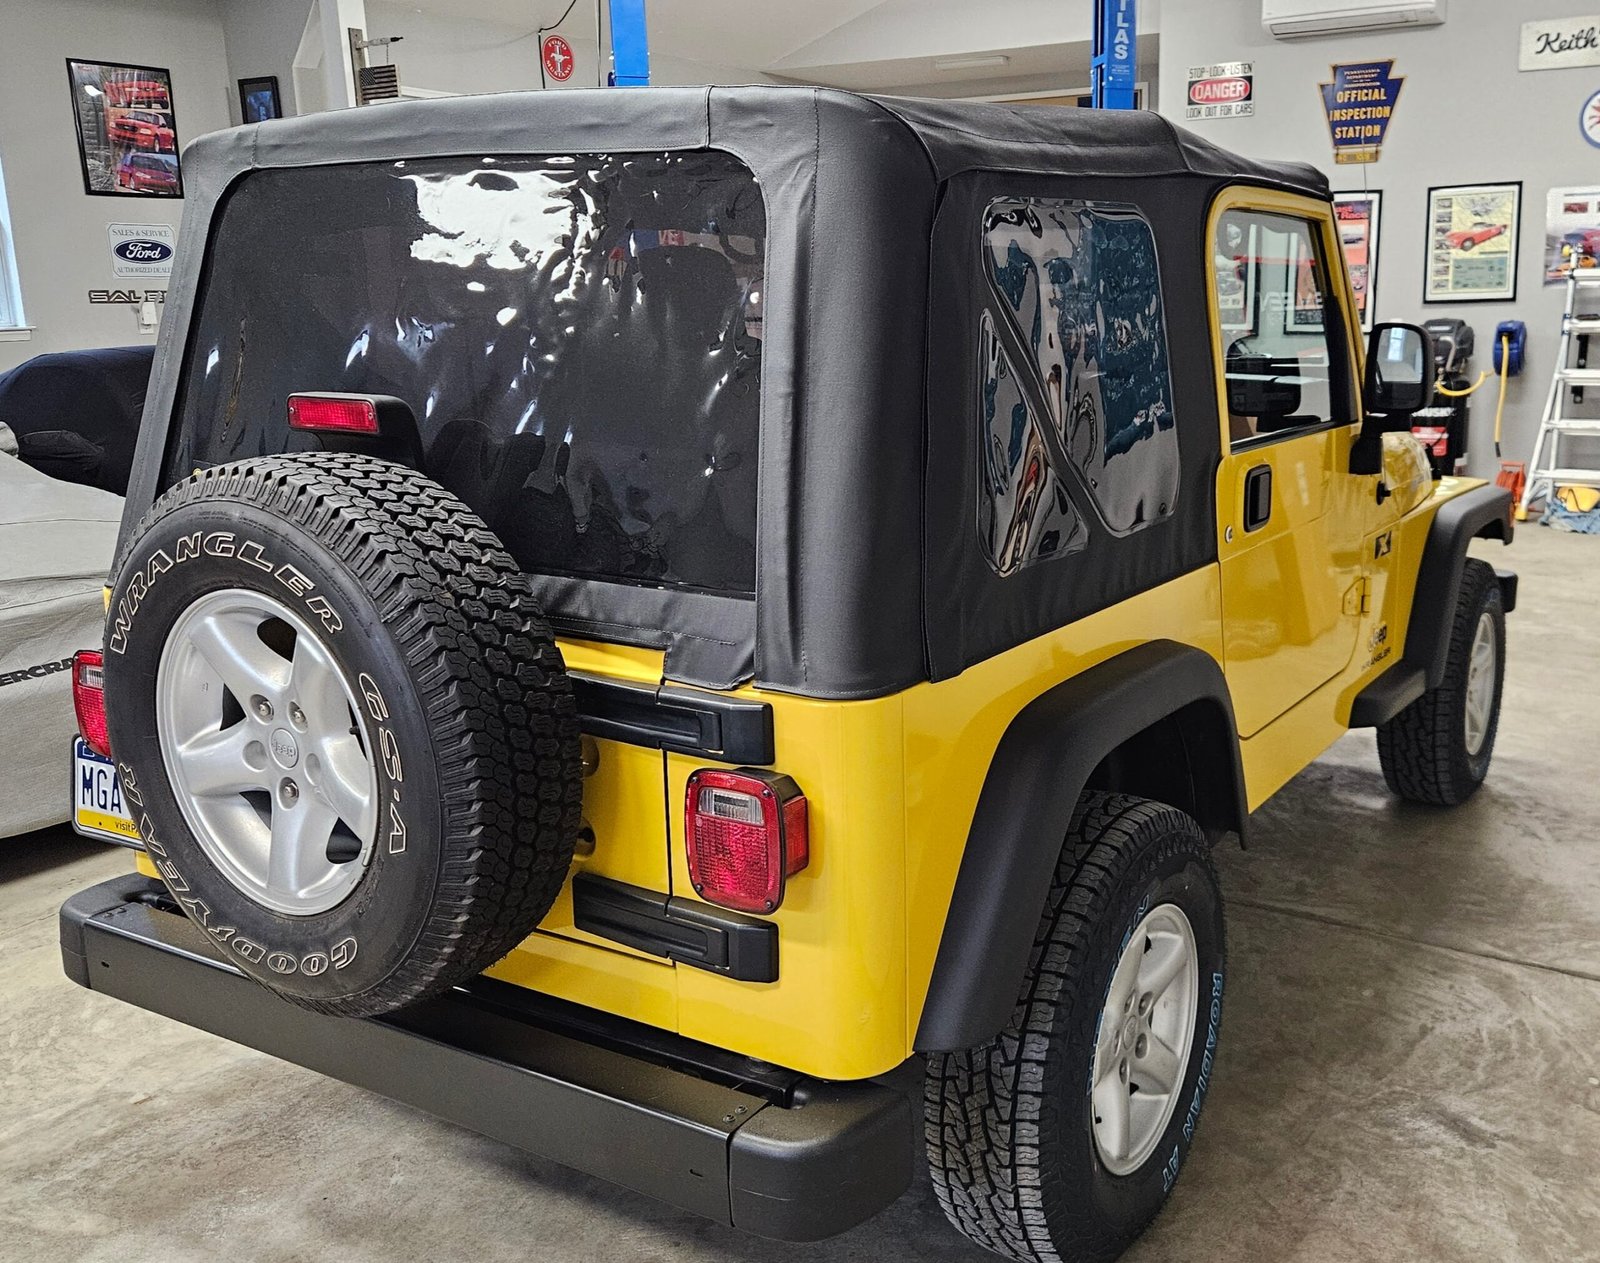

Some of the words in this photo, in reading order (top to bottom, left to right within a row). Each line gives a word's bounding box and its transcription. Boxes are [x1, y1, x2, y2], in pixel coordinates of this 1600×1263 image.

[1195, 81, 1246, 100] DANGER
[1336, 88, 1387, 103] OFFICIAL
[1186, 107, 1203, 119] LOOK
[1204, 106, 1218, 117] OUT
[1220, 105, 1233, 116] FOR
[1235, 103, 1253, 115] CARS
[1329, 106, 1391, 121] INSPECTION
[1335, 125, 1381, 139] STATION
[112, 229, 135, 237] SALES
[141, 229, 170, 237] SERVICE
[126, 242, 162, 259] Ford
[109, 531, 344, 655] WRANGLER
[82, 764, 122, 814] MGA
[118, 762, 358, 976] GOODYEAR
[1182, 972, 1223, 1143] ROADIAN
[1162, 1144, 1179, 1193] AT
